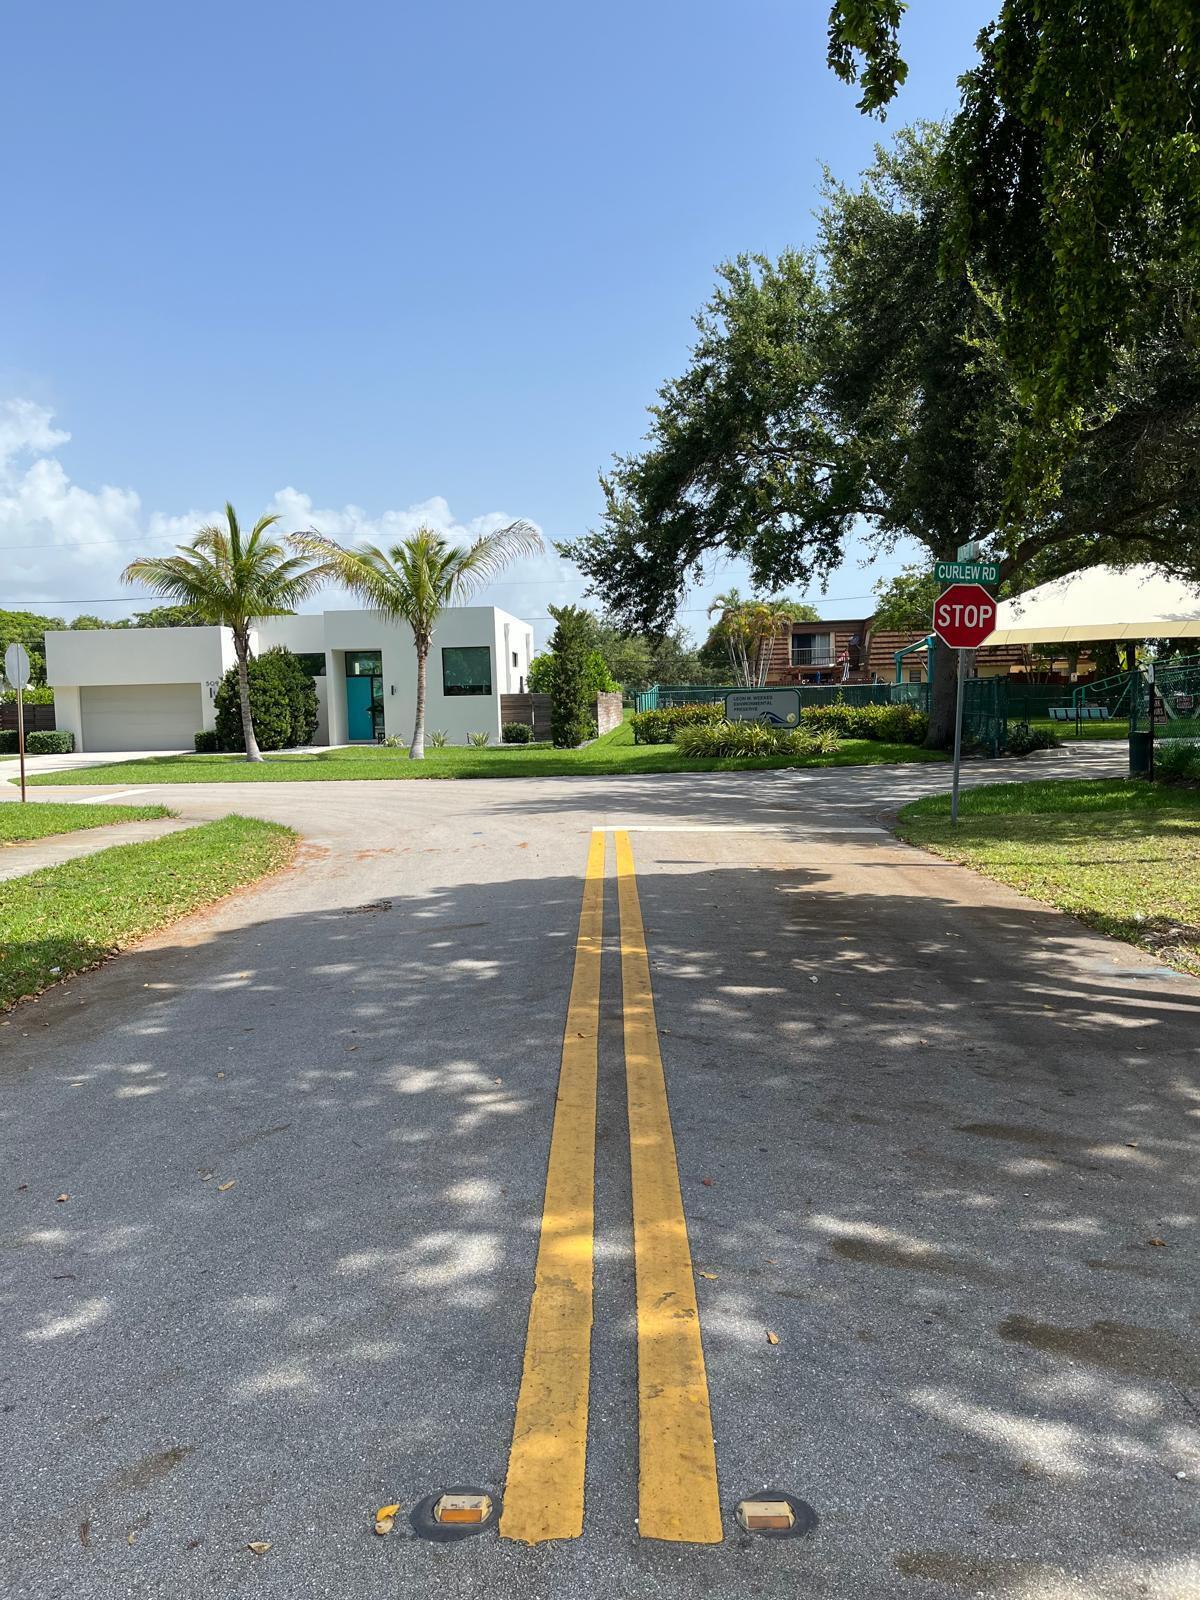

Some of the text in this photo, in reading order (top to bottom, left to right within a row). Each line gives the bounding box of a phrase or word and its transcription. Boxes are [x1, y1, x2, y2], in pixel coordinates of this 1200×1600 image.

[938, 565, 996, 580] CURLEW RD
[938, 604, 993, 628] STOP
